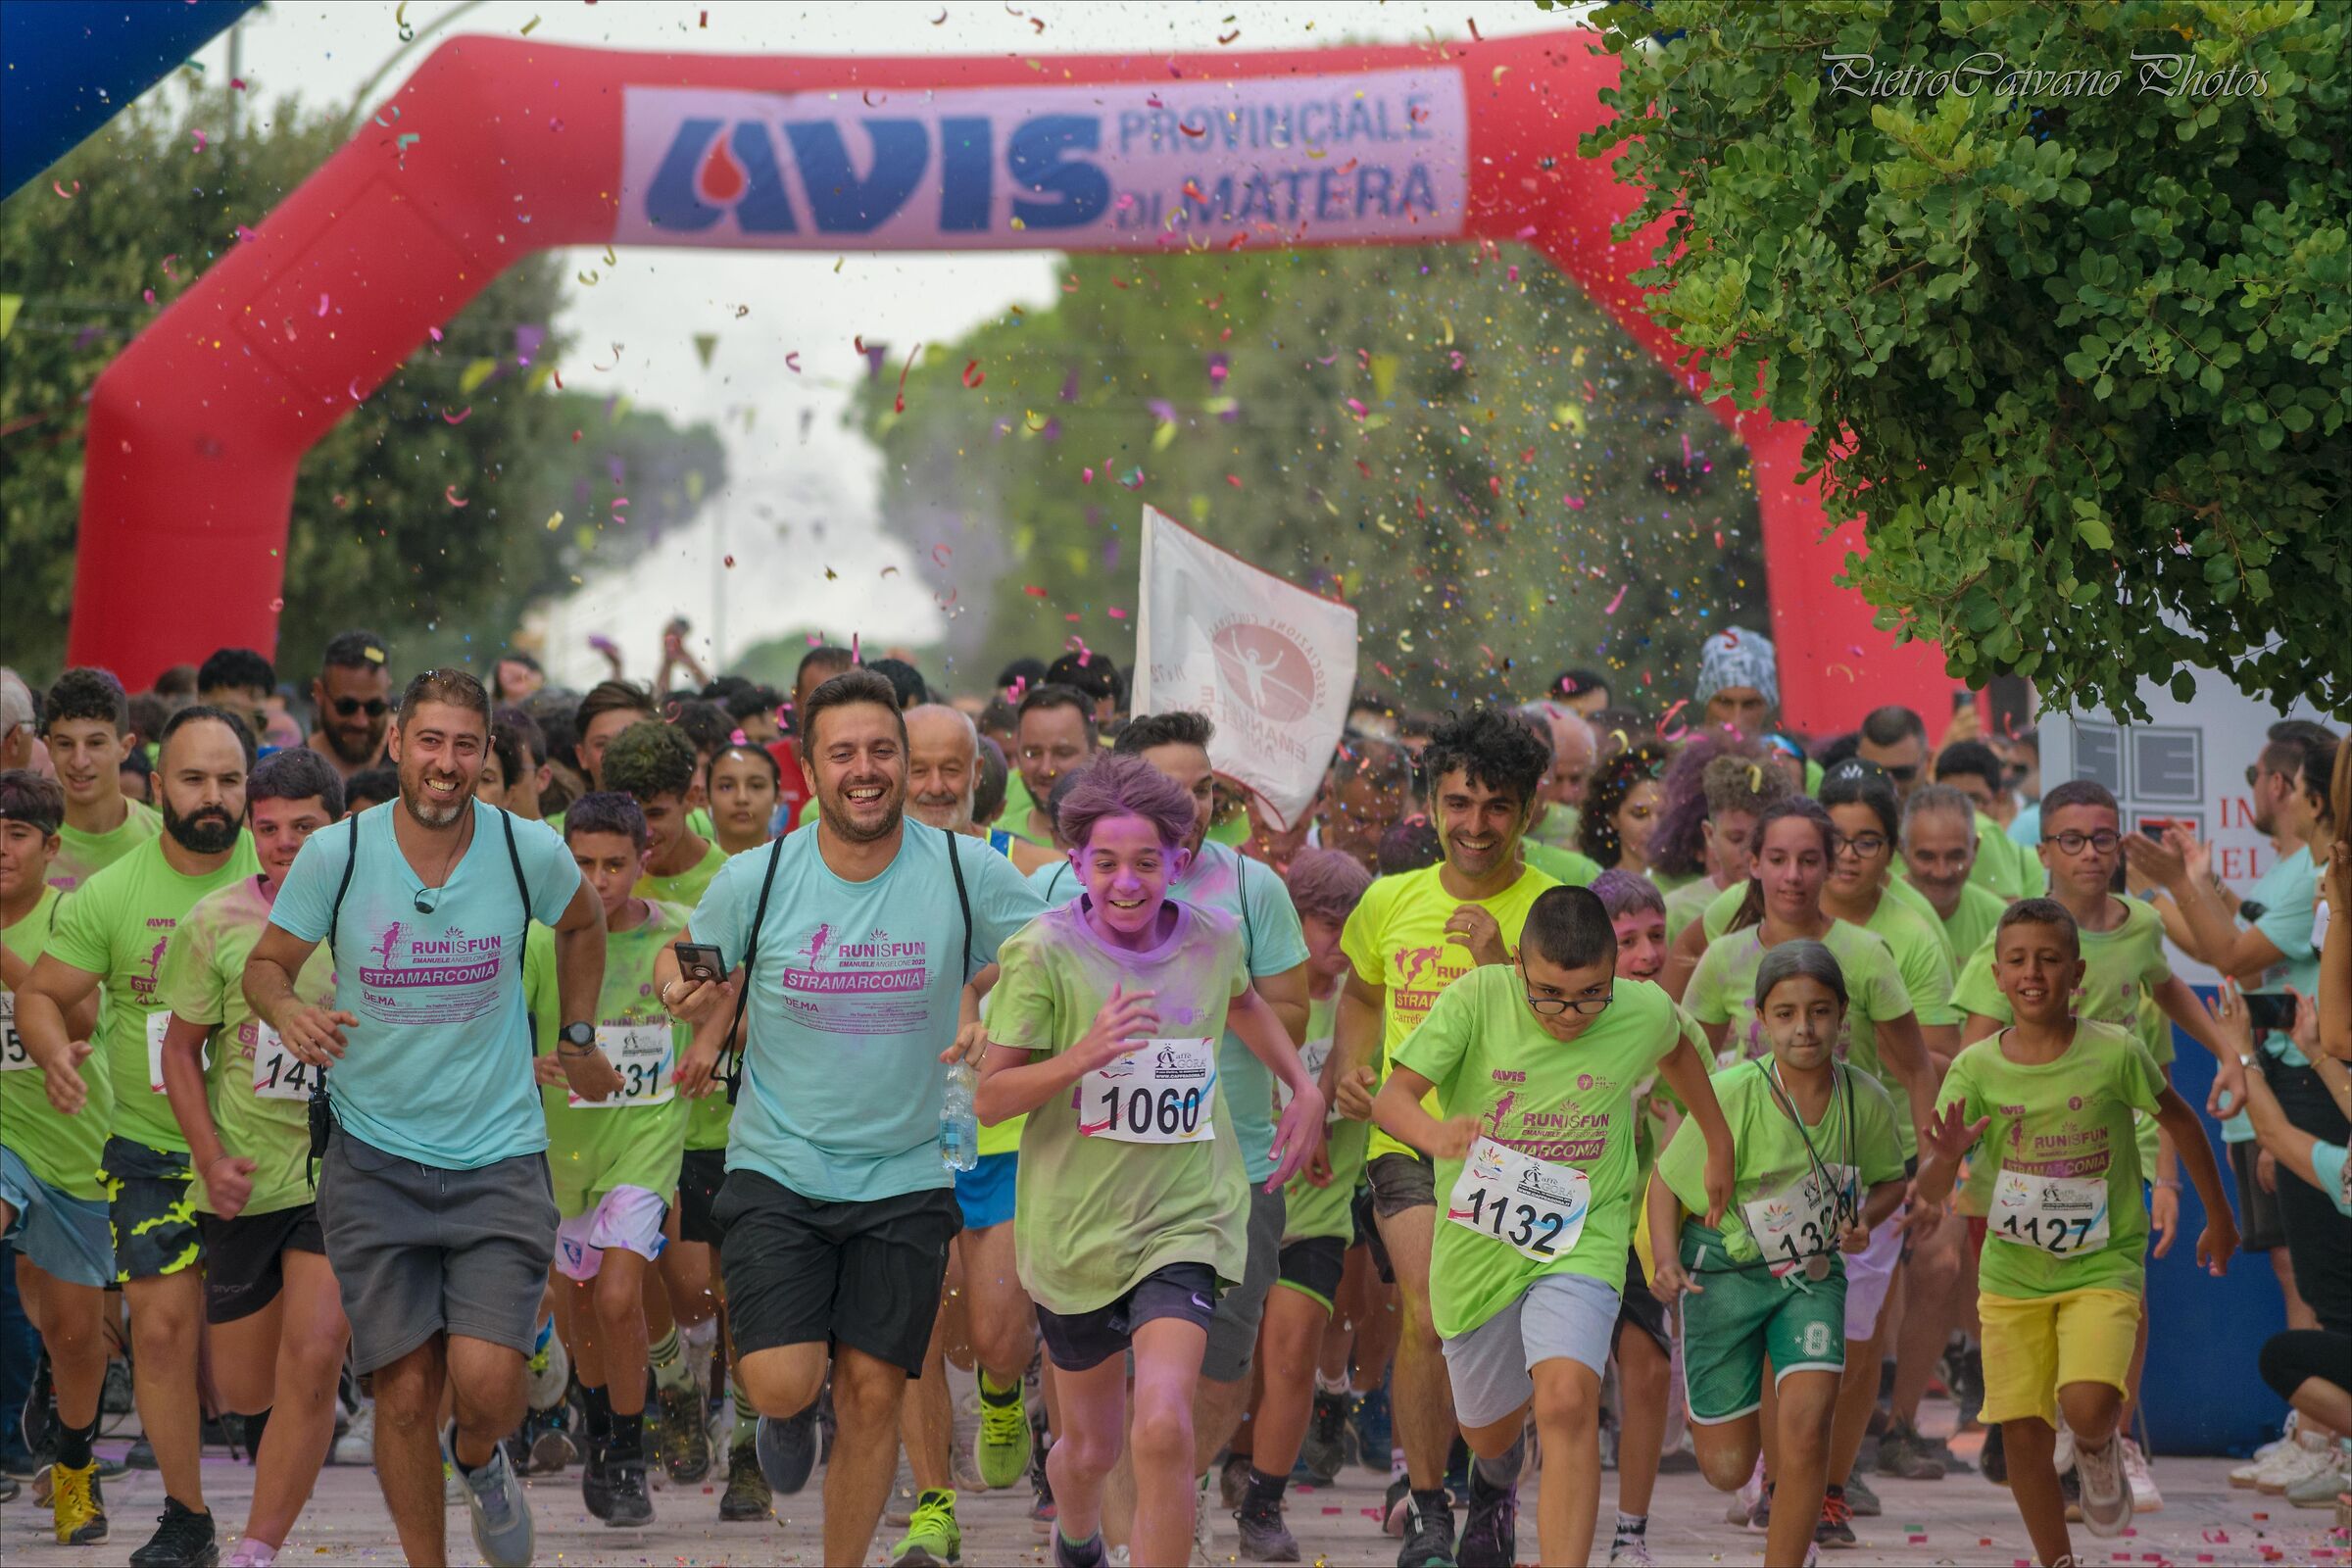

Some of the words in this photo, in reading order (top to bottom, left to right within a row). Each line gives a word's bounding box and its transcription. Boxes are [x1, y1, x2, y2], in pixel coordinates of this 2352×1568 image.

[1118, 94, 1433, 154] PROVINCIALE
[645, 114, 1111, 235] AVIS
[1184, 162, 1438, 227] MATERA
[146, 918, 176, 928] AVIS
[364, 963, 495, 985] STRAMARCONIA
[787, 972, 920, 990] STRAMARCONIA
[0, 1029, 26, 1062] 5
[1493, 1069, 1526, 1082] AVIS
[1102, 1086, 1200, 1134] 1060
[1505, 1143, 1600, 1157] MARCONIA
[1468, 1188, 1564, 1255] 1132
[2003, 1215, 2092, 1252] 1127
